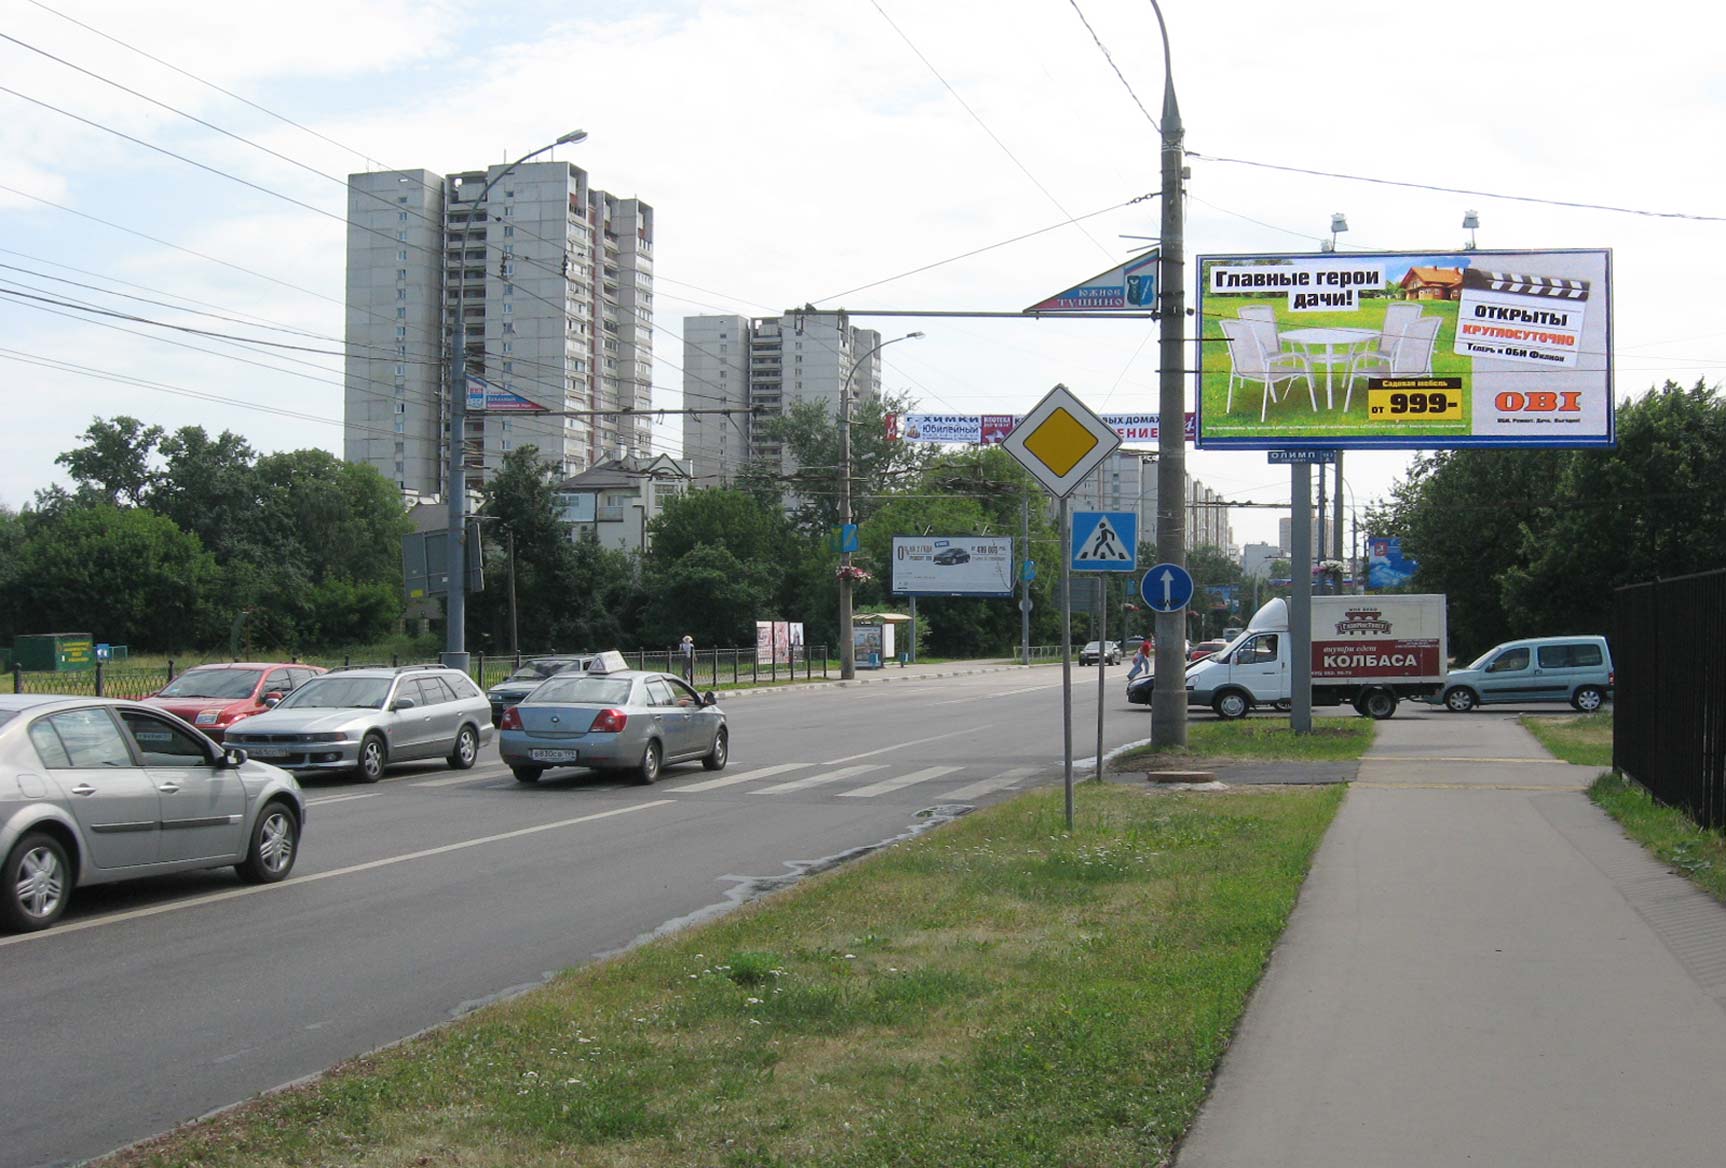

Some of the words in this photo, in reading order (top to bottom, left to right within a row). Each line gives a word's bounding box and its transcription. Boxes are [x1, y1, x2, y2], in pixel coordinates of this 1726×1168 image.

[1215, 271, 1310, 288] Главные
[1316, 270, 1379, 288] герои
[1056, 298, 1123, 308] ТУШИНО
[1293, 289, 1353, 309] дачи!
[1474, 305, 1568, 326] ОТКРЫТЫ
[1462, 324, 1575, 346] КРУГЛОСУТОЧНО
[1505, 347, 1528, 358] ОБИ
[1494, 391, 1582, 412] OBI
[922, 424, 979, 434] Юбилейный
[1271, 451, 1316, 459] ОЛИМП
[1323, 654, 1418, 668] КОЛБАСА
